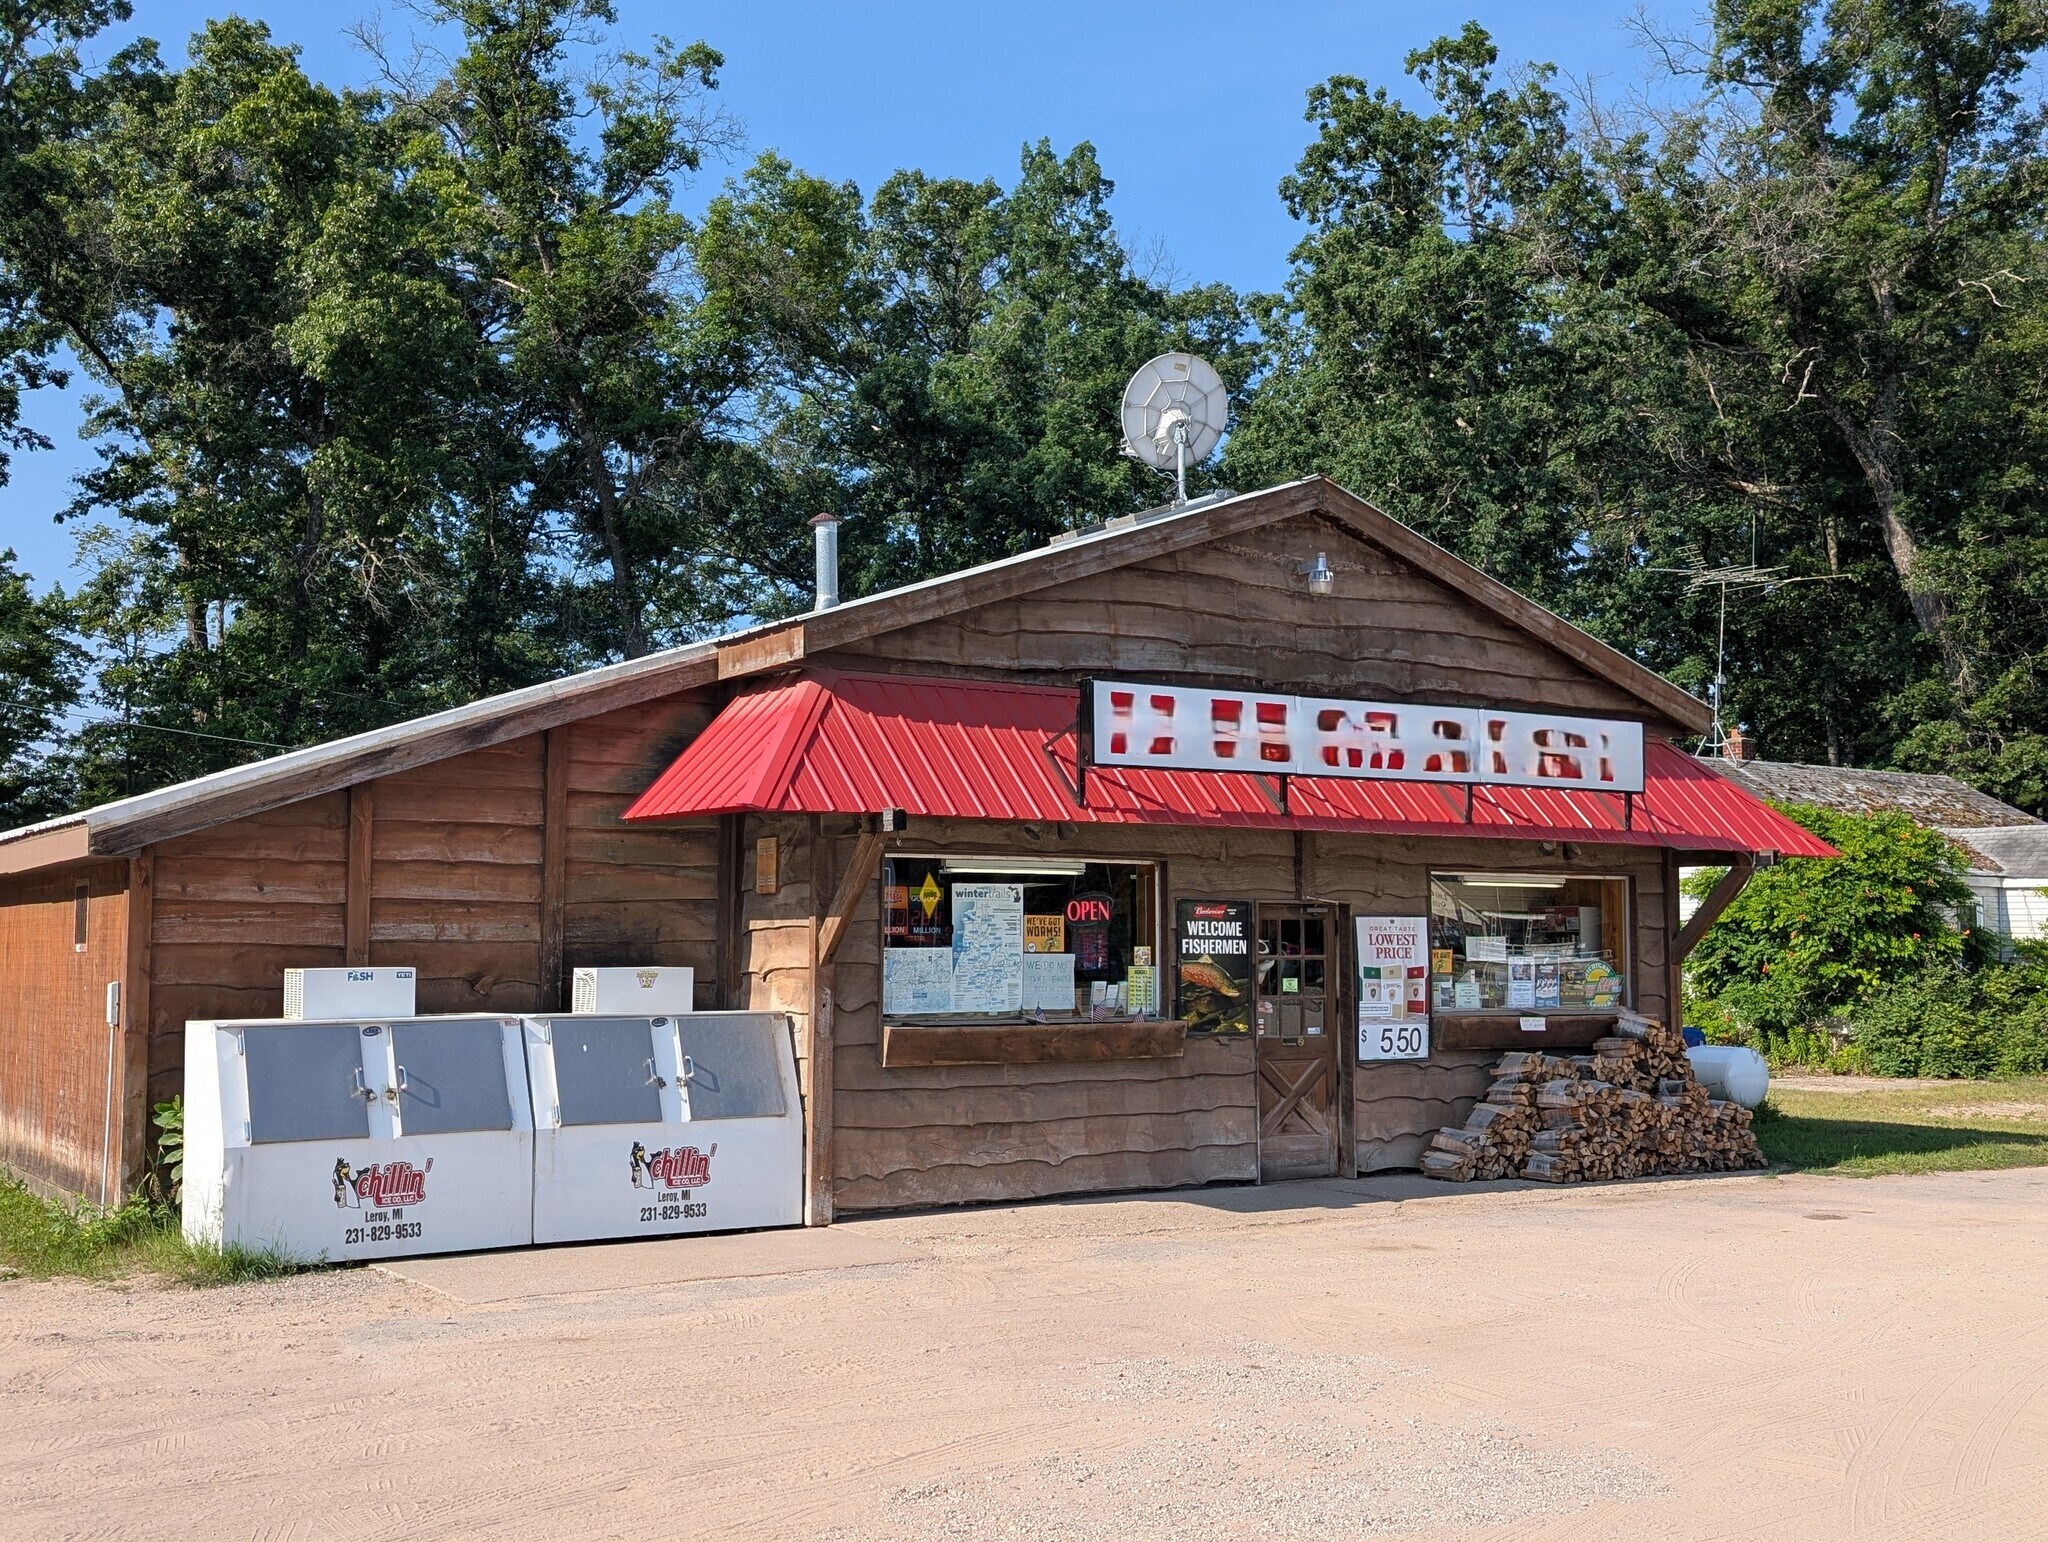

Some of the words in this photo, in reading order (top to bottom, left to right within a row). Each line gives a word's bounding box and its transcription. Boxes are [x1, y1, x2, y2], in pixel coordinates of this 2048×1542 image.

[1067, 900, 1109, 921] OPEN
[1194, 906, 1225, 915] Budweiser
[1026, 917, 1047, 925] WE'VE
[1048, 917, 1061, 925] GOT
[884, 926, 905, 934] LLION
[912, 926, 941, 934] MILLION
[1026, 926, 1061, 937] WORMS!
[1187, 921, 1243, 937] WELCOME
[1368, 933, 1418, 946] LOWEST
[1182, 938, 1247, 955] FISHERMEN
[1375, 947, 1412, 959] PRICE
[1026, 960, 1041, 970] WE
[1043, 960, 1054, 971] DO
[1383, 982, 1402, 990] CROWNS
[1361, 1028, 1368, 1043] $
[1380, 1027, 1422, 1055] 5.50
[382, 1196, 391, 1204] ICE
[658, 1191, 680, 1203] Leroy,
[681, 1189, 691, 1200] MI
[365, 1211, 390, 1223] Leroy,
[392, 1208, 403, 1220] MI
[640, 1203, 707, 1222] 231-829-9533
[345, 1222, 421, 1244] 231-829-9533
